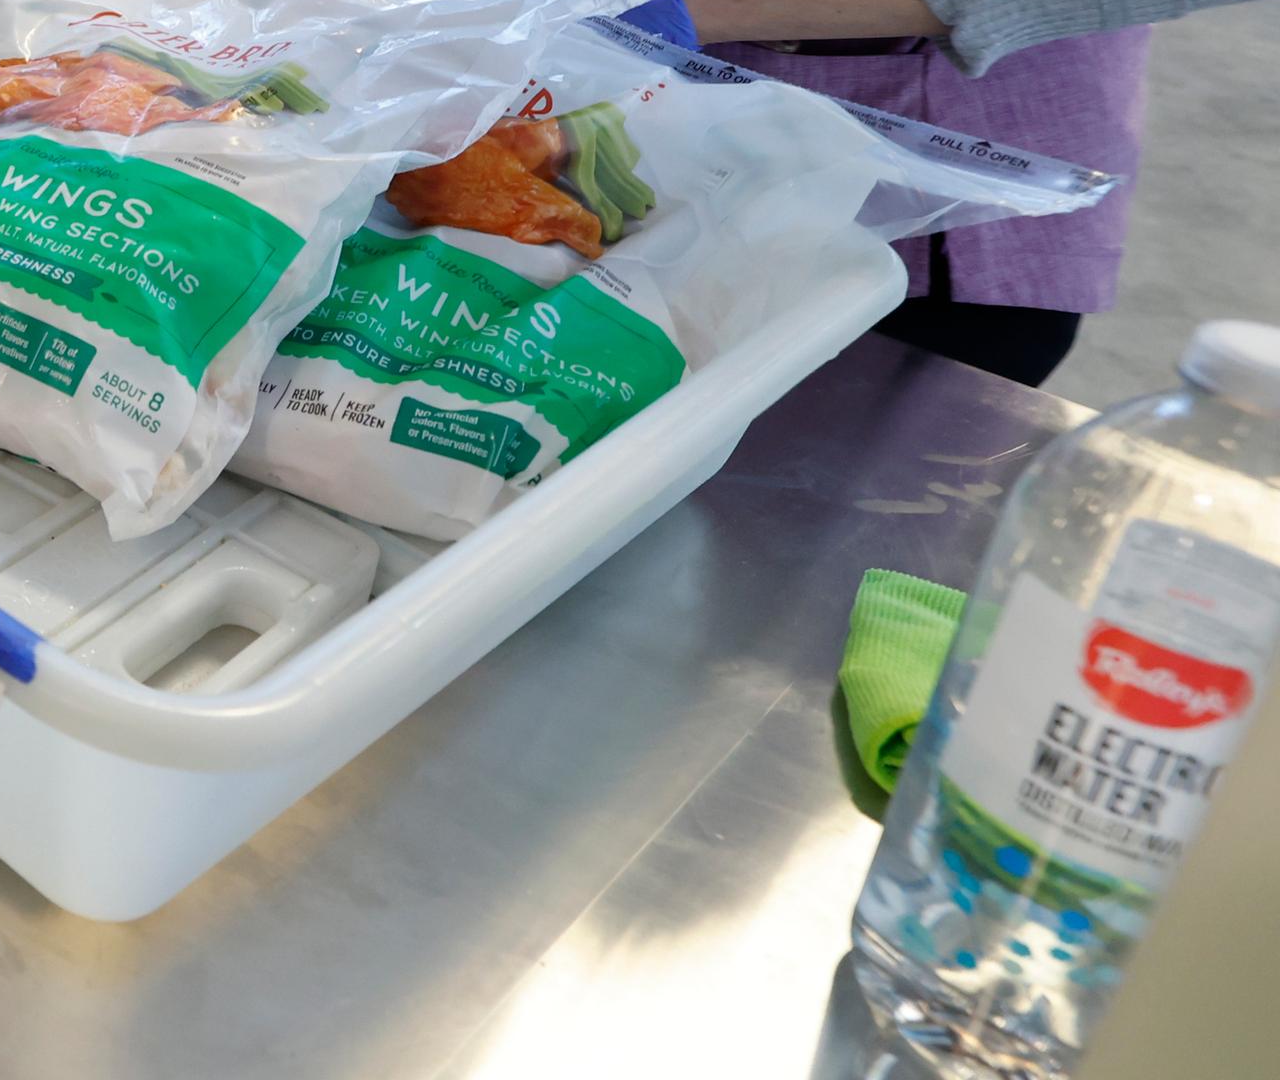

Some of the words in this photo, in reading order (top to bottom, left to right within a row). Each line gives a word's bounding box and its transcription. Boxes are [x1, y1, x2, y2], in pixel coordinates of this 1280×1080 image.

[685, 59, 714, 77] PULL
[715, 67, 733, 83] TO
[929, 133, 964, 150] PULL
[967, 143, 986, 158] TO
[988, 150, 1031, 169] OPEN
[1, 165, 154, 230] WINGS
[0, 197, 60, 230] WING
[66, 221, 201, 295] SECTIONS
[25, 231, 86, 261] NATURAL
[89, 252, 178, 311] FLAVORINGS
[397, 263, 562, 340] WINS
[1, 328, 30, 349] Flavors
[291, 326, 315, 341] TO
[320, 330, 391, 369] ENSURE
[400, 309, 451, 347] WIN
[480, 324, 636, 403] SECTIONS
[44, 349, 77, 372] Protein
[91, 383, 162, 435] SERVINGS
[99, 370, 148, 403] ABOUT
[147, 391, 166, 413] 8
[286, 400, 300, 410] TO
[300, 401, 328, 417] COOK
[291, 388, 325, 401] READY
[346, 400, 376, 413] KEEP
[340, 410, 386, 429] FROZEN
[449, 423, 486, 442] Flavors
[407, 428, 421, 437] or
[420, 430, 489, 459] Preservatives
[1030, 738, 1166, 826] WATER
